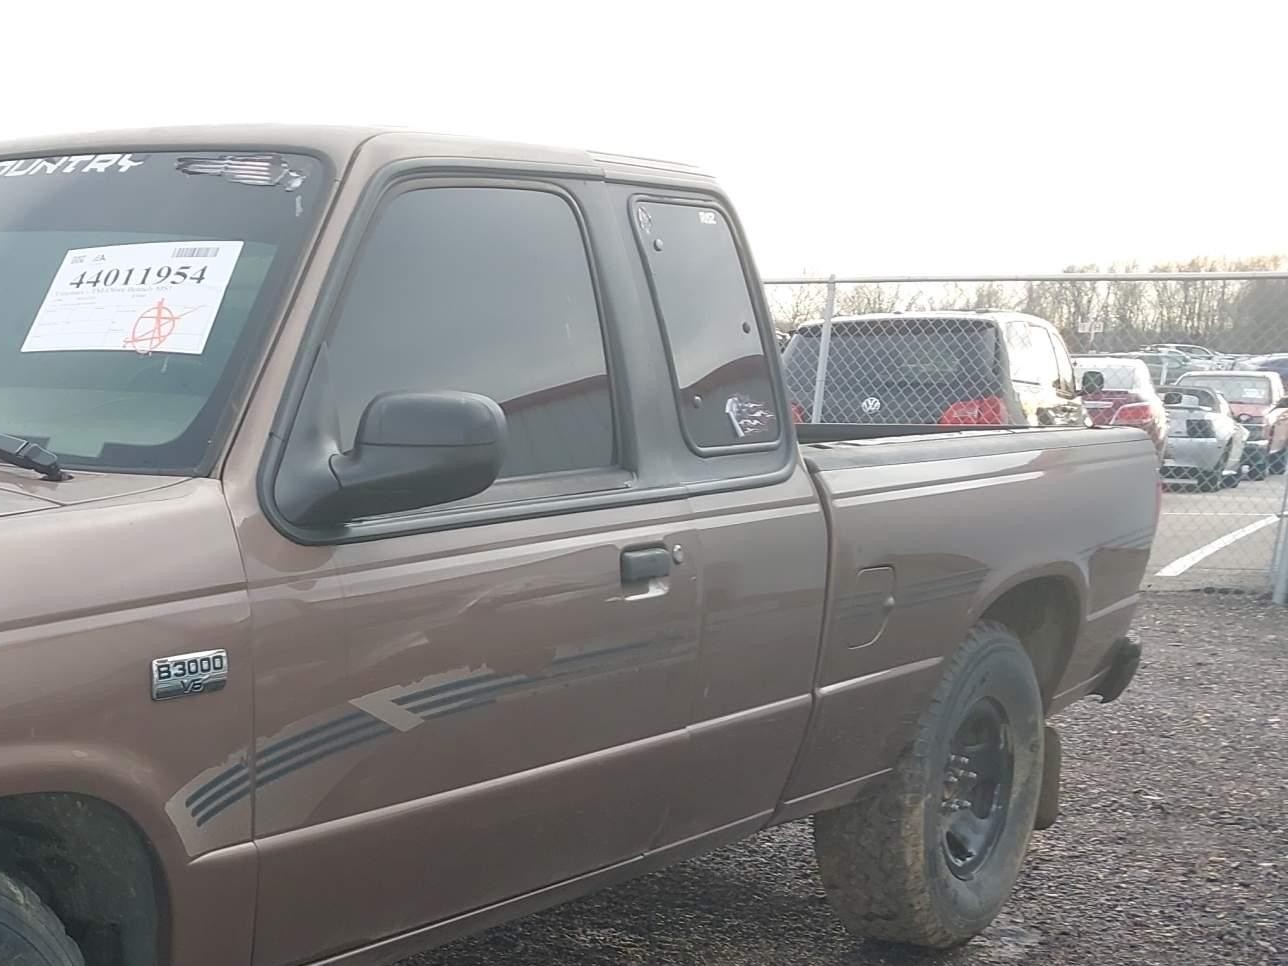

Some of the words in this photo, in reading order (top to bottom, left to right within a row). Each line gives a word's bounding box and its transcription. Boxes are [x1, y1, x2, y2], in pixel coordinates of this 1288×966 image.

[69, 265, 208, 289] 44011954
[157, 655, 224, 681] B3000
[180, 678, 204, 693] V6
